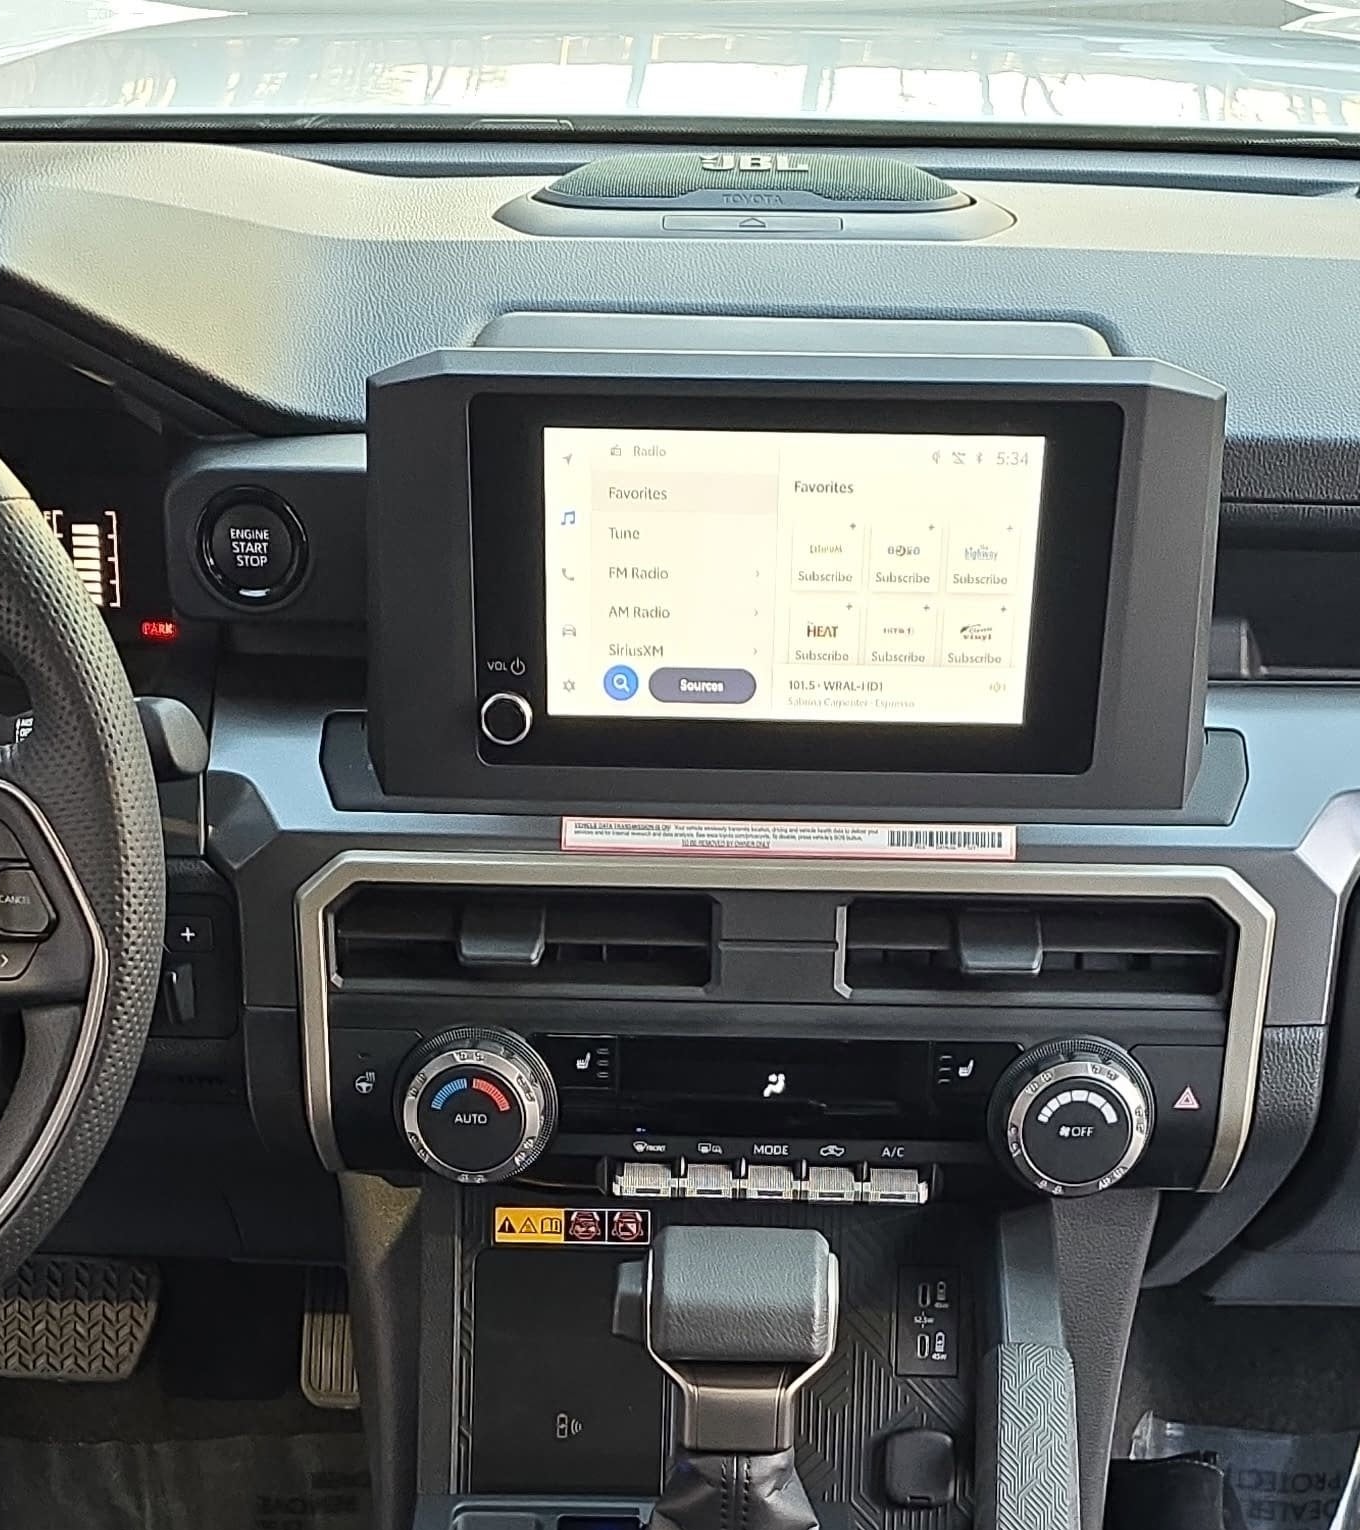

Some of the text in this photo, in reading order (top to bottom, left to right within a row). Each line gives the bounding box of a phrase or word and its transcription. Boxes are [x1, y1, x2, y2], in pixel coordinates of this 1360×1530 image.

[722, 193, 784, 204] TOYOTA
[633, 444, 667, 457] Radio
[996, 451, 1030, 466] 5:34
[609, 486, 668, 501] Favorites
[793, 480, 855, 495] Favorites
[230, 528, 270, 541] ENGINE
[609, 526, 641, 540] Tune
[232, 541, 269, 554] START
[236, 555, 268, 567] STOP
[609, 566, 669, 580] FM Radio
[798, 570, 854, 583] Subscribe
[875, 571, 930, 584] Subscribe
[953, 572, 1008, 585] Subscribe
[609, 605, 671, 619] AM Radio
[143, 621, 175, 636] PARK
[609, 642, 665, 657] SiriusXM
[795, 650, 849, 662] Subscribe
[871, 651, 925, 663] Subscribe
[947, 652, 1002, 664] Subscribe
[487, 661, 507, 671] VOL
[679, 678, 725, 693] Sources
[789, 680, 815, 691] 101.5
[454, 1113, 488, 1125] AUTO
[1071, 1126, 1095, 1137] OFF
[753, 1144, 789, 1156] MODE
[881, 1146, 905, 1158] A/C
